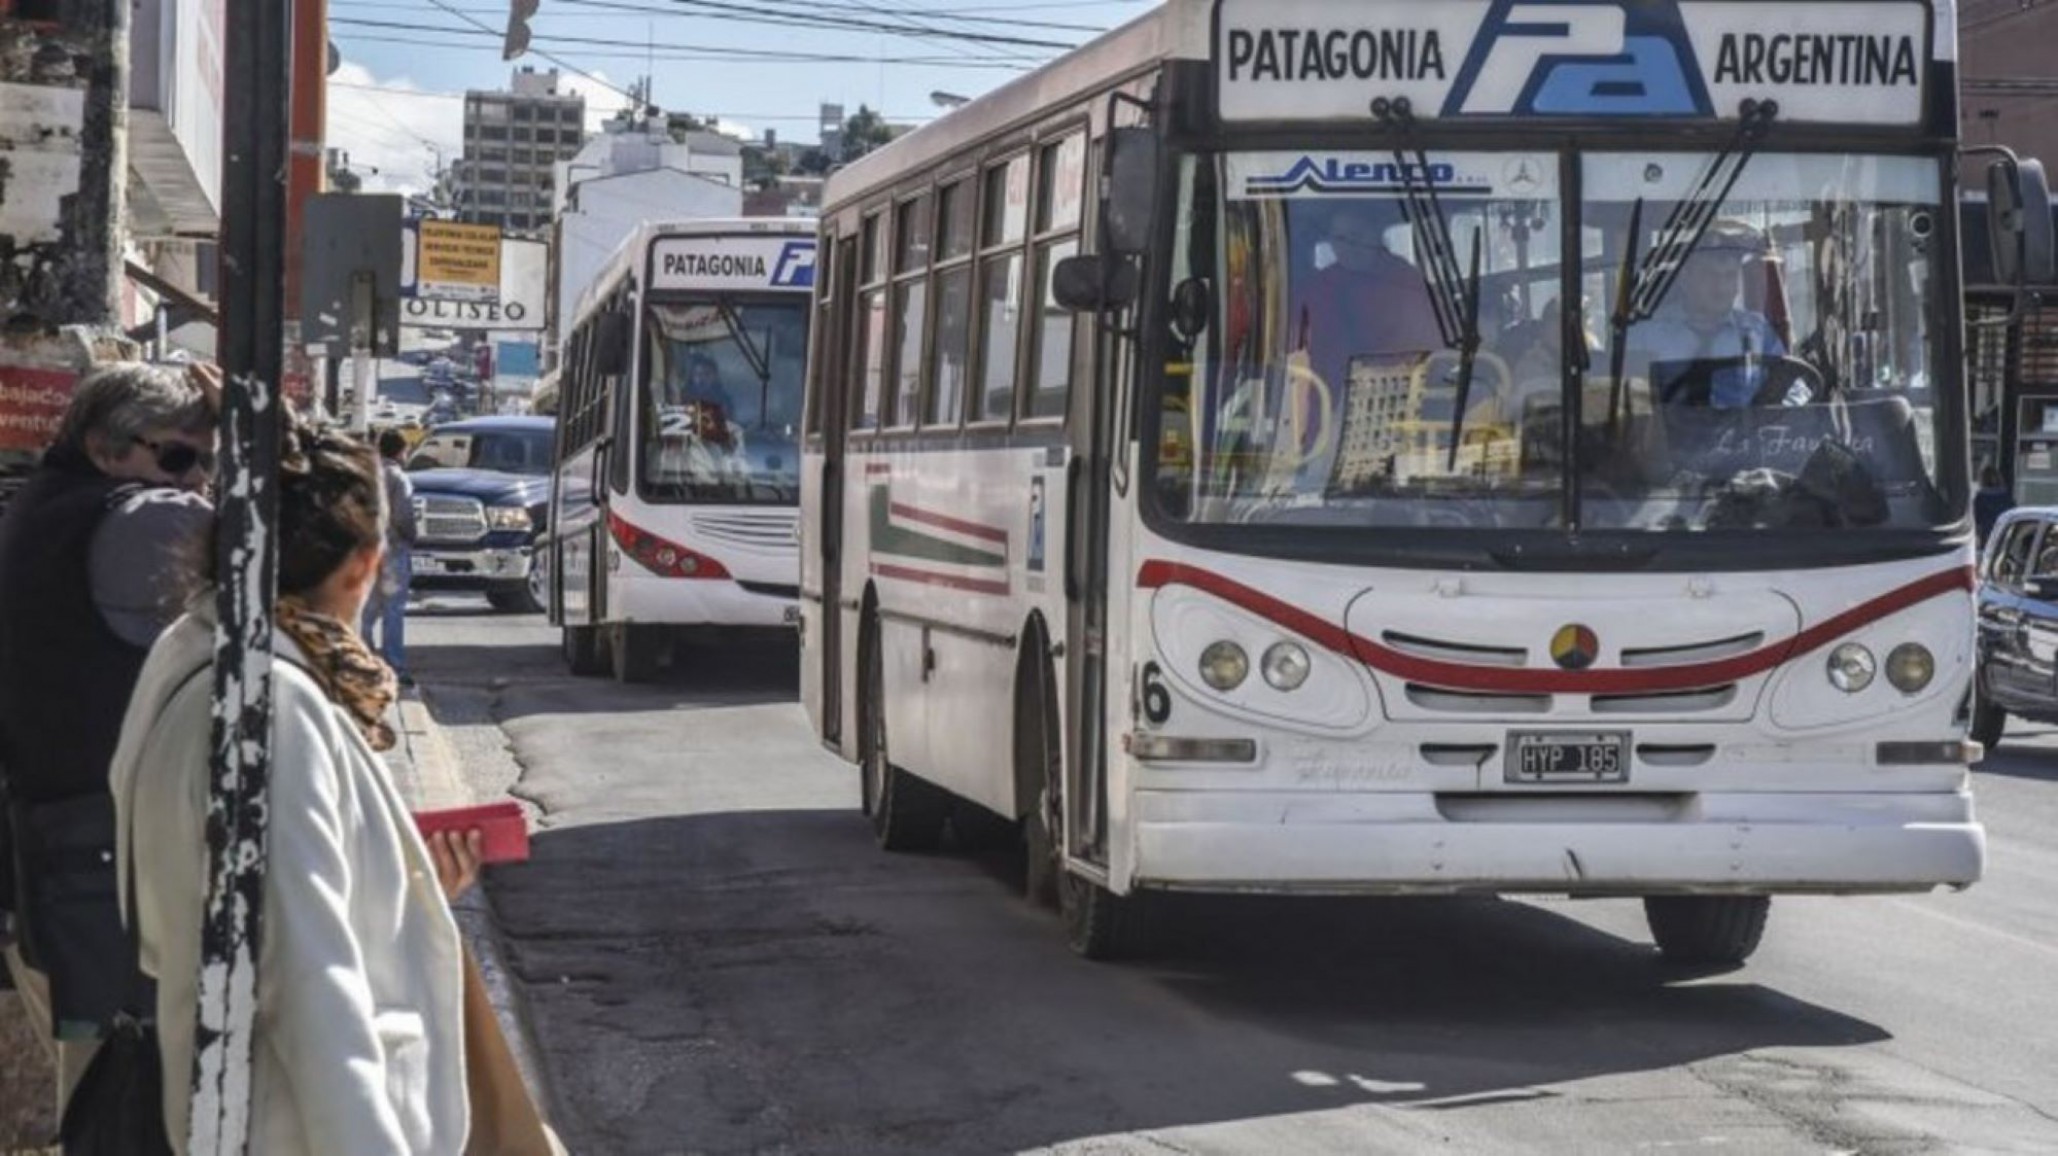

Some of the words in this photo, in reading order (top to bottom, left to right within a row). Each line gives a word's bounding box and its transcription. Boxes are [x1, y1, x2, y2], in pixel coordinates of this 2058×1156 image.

[1228, 29, 1446, 82] PATAGONIA
[1713, 32, 1917, 87] ARGENTINA
[663, 253, 766, 277] PATAGONIA
[406, 298, 526, 322] OLISEO
[1522, 745, 1564, 772] HYP
[1577, 745, 1618, 772] 185
